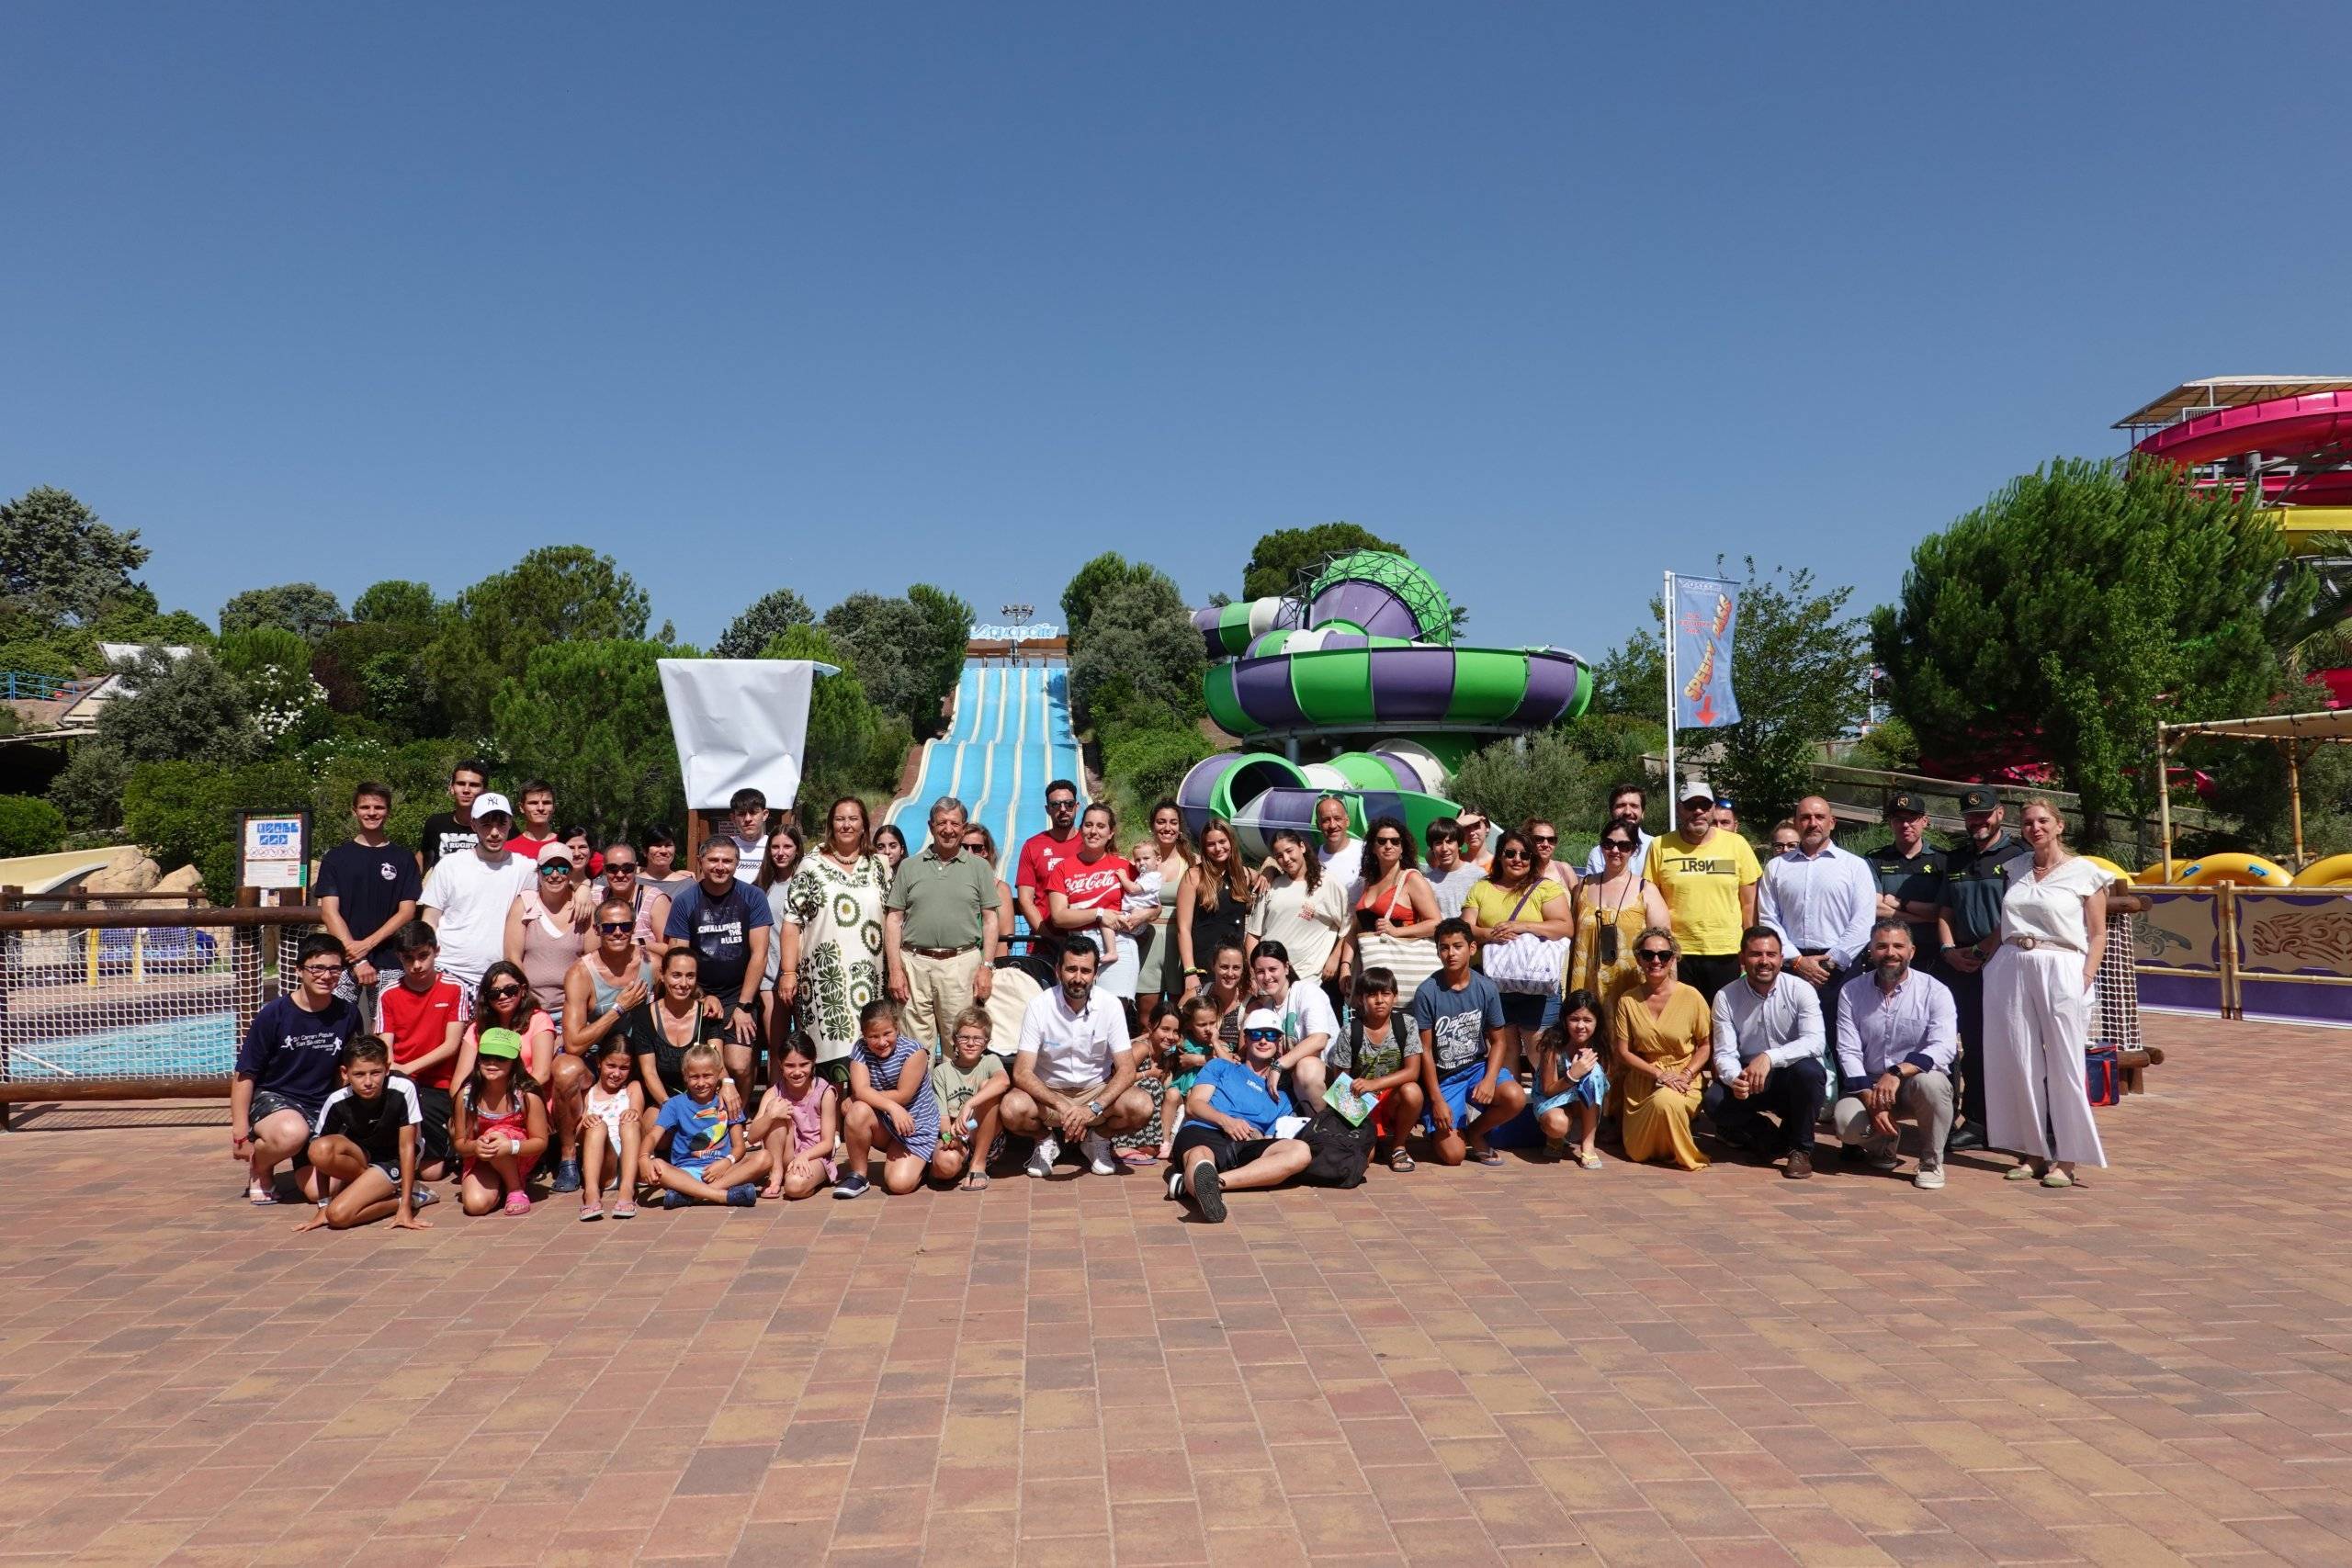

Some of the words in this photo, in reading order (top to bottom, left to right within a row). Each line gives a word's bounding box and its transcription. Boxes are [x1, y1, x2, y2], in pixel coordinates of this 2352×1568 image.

[1683, 637, 1715, 702] SPEEDY
[697, 921, 741, 933] CHALLENGE
[720, 936, 743, 944] RULES
[1434, 1009, 1482, 1037] Daytona
